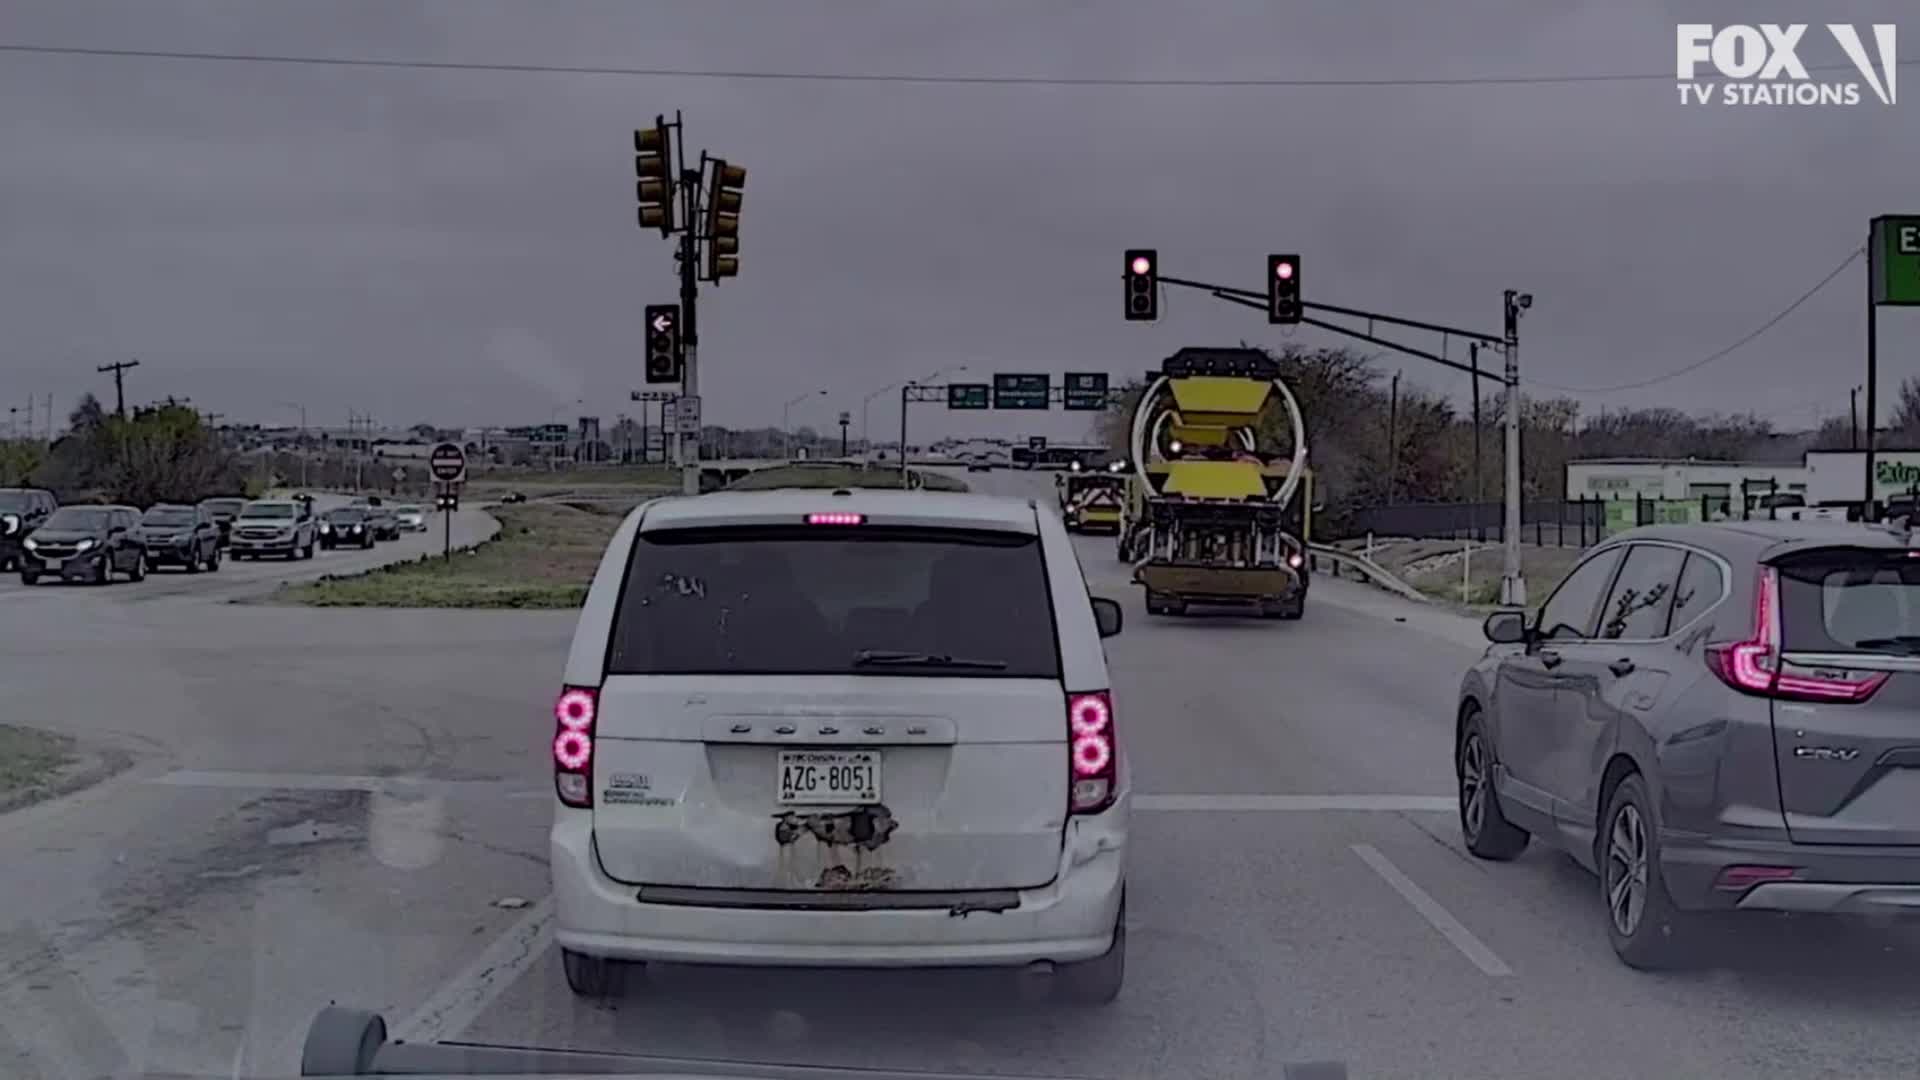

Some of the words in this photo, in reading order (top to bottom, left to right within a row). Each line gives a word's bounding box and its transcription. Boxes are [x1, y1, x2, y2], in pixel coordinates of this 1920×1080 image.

[1901, 227, 1920, 252] E
[1795, 748, 1858, 760] CR-V
[783, 766, 873, 791] AZG-8051
